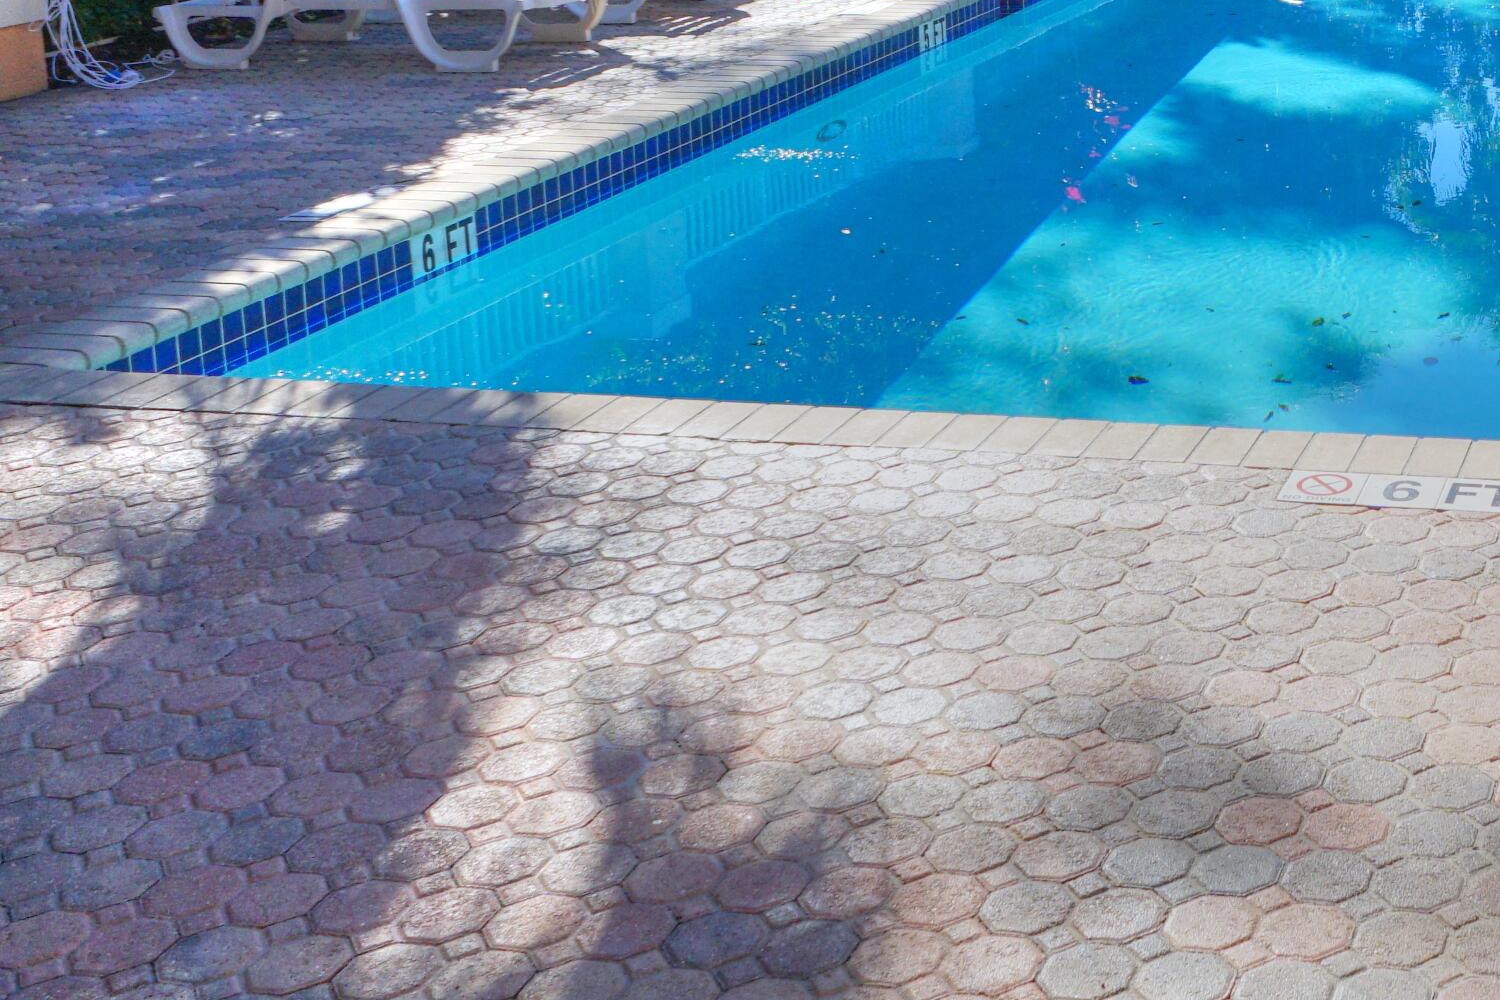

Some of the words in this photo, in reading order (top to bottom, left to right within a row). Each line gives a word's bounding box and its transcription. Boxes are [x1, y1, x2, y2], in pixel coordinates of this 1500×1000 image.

[422, 233, 436, 273] 6
[445, 215, 474, 263] FT
[1382, 480, 1423, 502] 6
